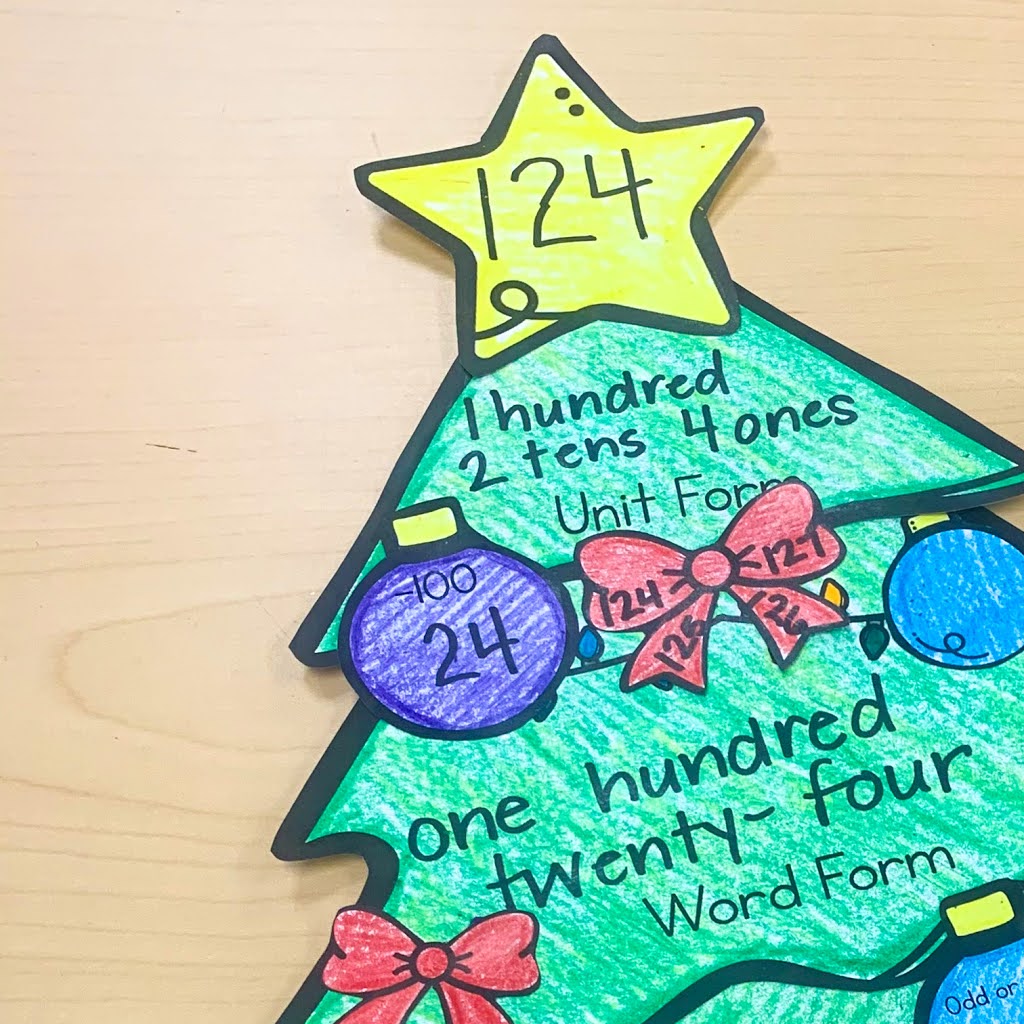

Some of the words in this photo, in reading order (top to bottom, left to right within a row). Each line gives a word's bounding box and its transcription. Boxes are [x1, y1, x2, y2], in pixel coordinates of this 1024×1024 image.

[478, 149, 653, 260] 124
[464, 396, 480, 441] 1
[490, 349, 730, 432] hundred
[458, 450, 508, 492] 2
[522, 428, 647, 478] tens
[681, 404, 719, 453] 4
[734, 394, 859, 446] ones
[554, 482, 656, 534] Unit
[394, 563, 477, 604] -100
[599, 579, 664, 628] 124
[423, 606, 520, 687] 24
[408, 794, 537, 862] one
[585, 673, 896, 813] hundred
[803, 744, 973, 828] four
[643, 864, 803, 937] Word
[816, 845, 957, 901] Form
[945, 985, 990, 1015] Odd
[996, 982, 1018, 999] or
